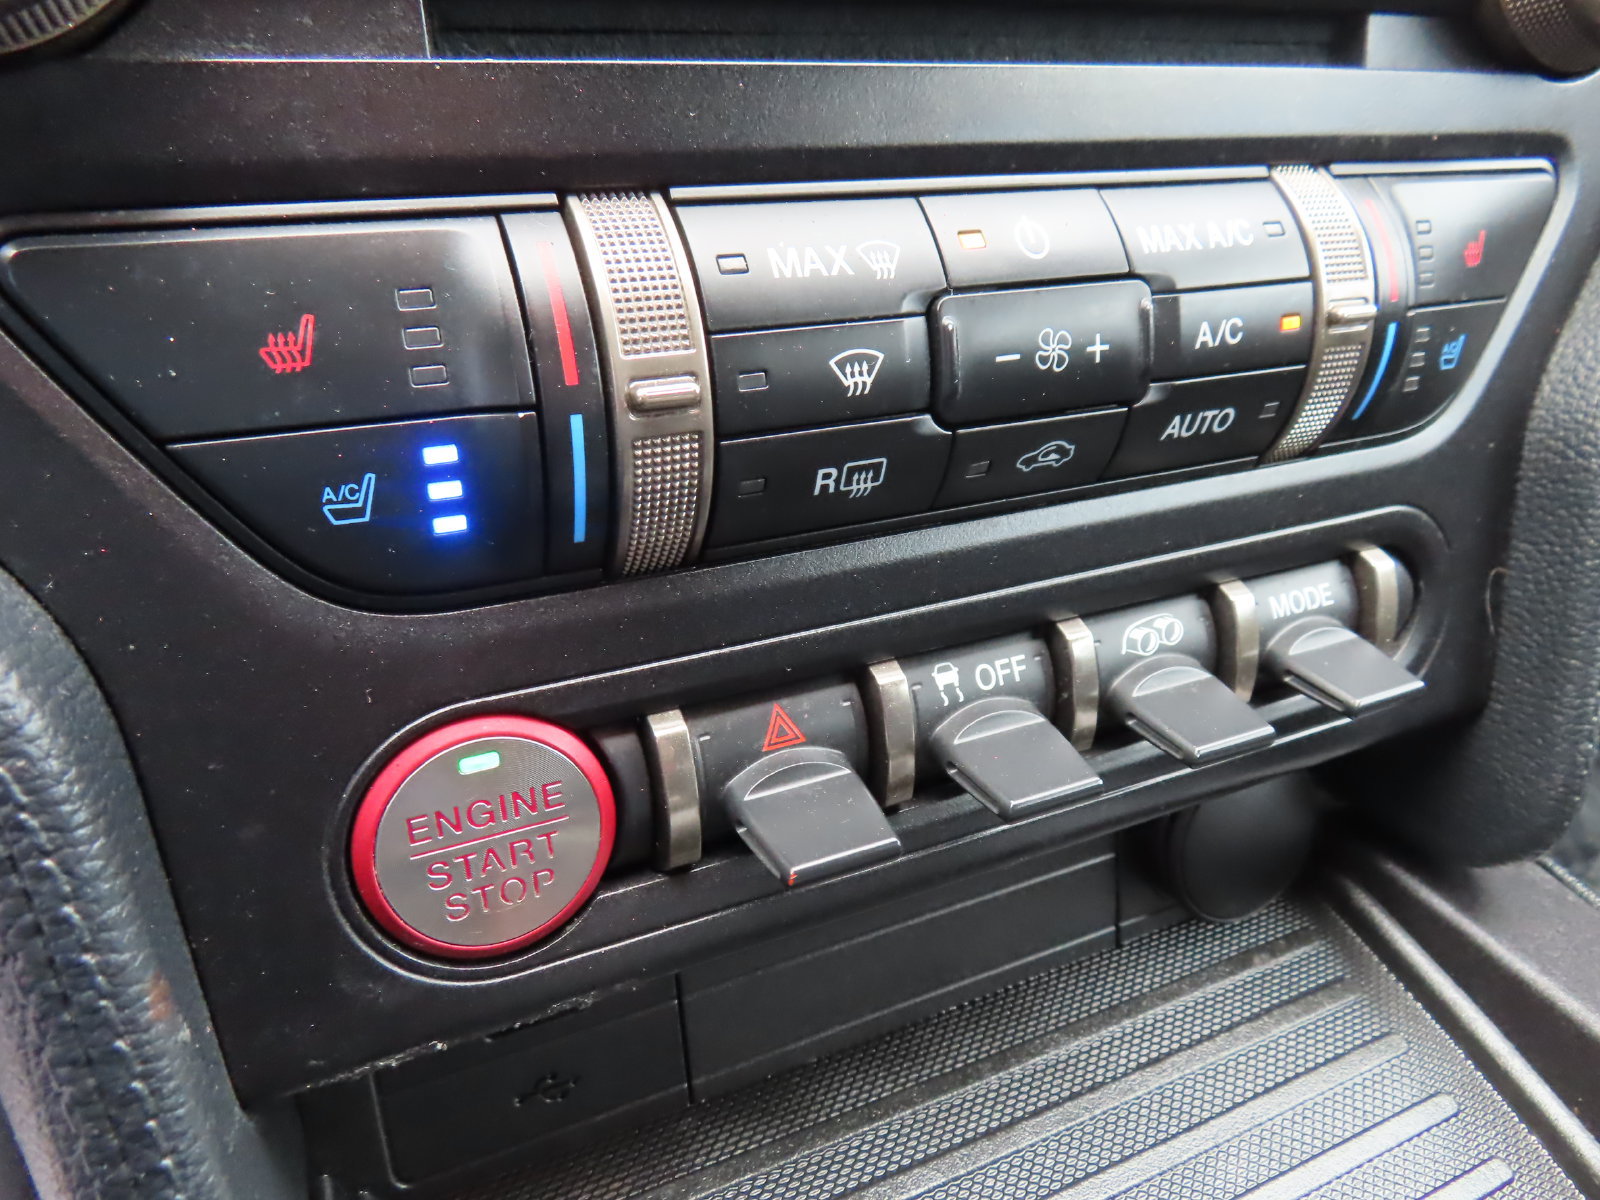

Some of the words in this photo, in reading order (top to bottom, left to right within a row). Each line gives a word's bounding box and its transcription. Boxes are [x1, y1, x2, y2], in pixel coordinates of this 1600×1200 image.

[1138, 225, 1203, 254] MAX
[1208, 220, 1254, 249] A/C
[769, 247, 853, 278] MAX
[1195, 318, 1243, 350] A/C
[1160, 409, 1235, 440] AUTO
[322, 485, 359, 504] A/C
[814, 467, 836, 495] R
[1270, 582, 1334, 619] MODE
[975, 655, 1027, 690] OFF
[406, 781, 565, 844] ENGINE
[426, 831, 559, 889] START
[445, 868, 556, 922] STOP
